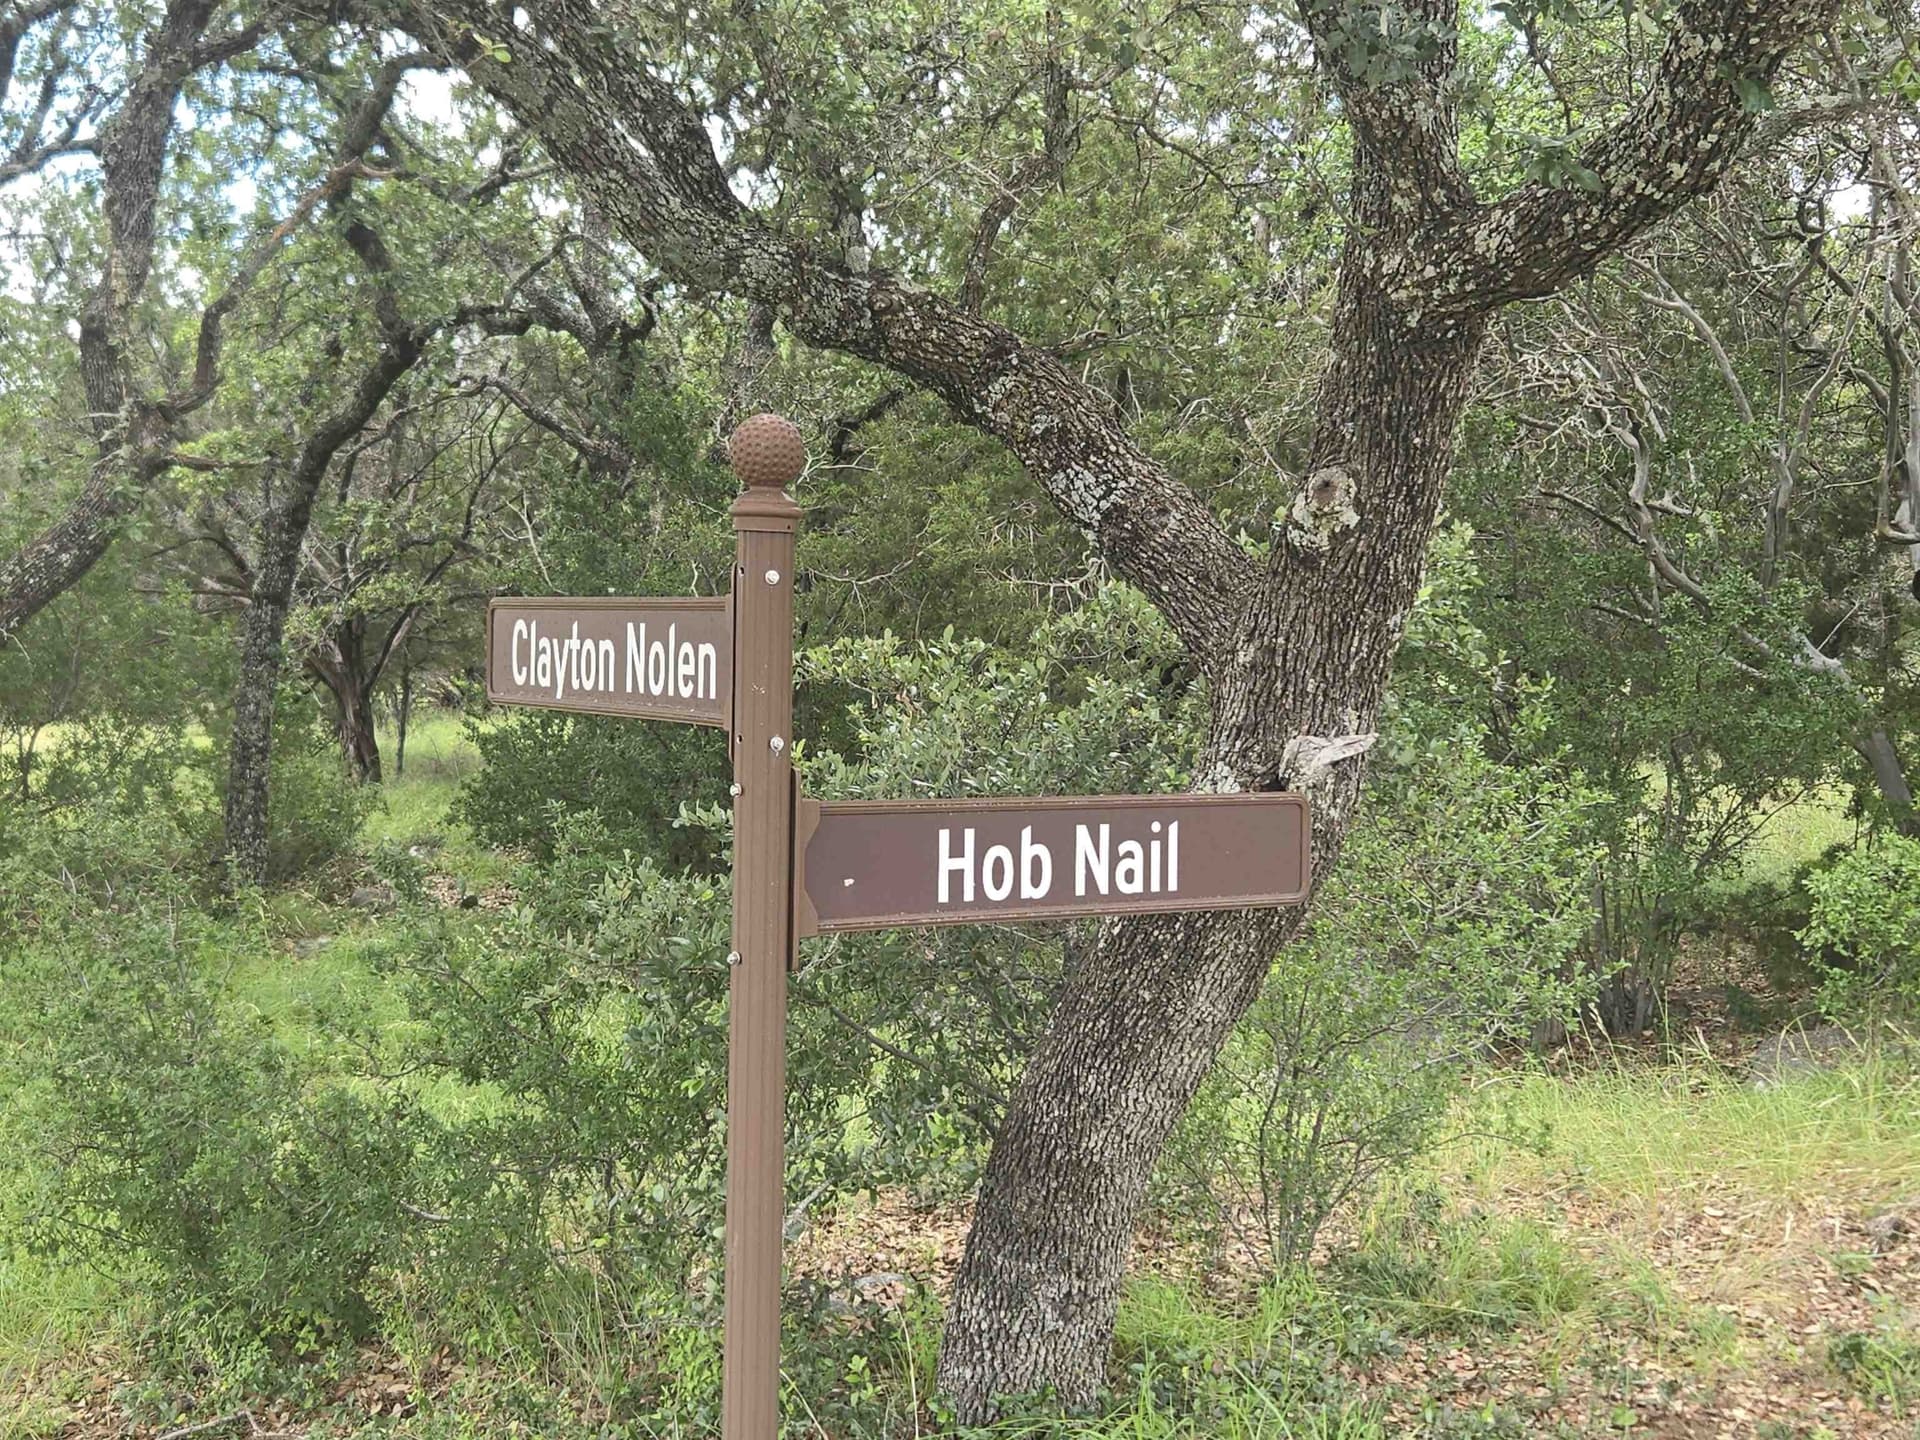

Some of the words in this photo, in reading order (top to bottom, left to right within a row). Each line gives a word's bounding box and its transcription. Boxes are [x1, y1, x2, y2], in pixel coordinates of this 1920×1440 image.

[511, 618, 616, 700] Clayton
[625, 621, 717, 700] Nolen
[937, 825, 1053, 904] Hob
[1074, 820, 1180, 897] Nail
